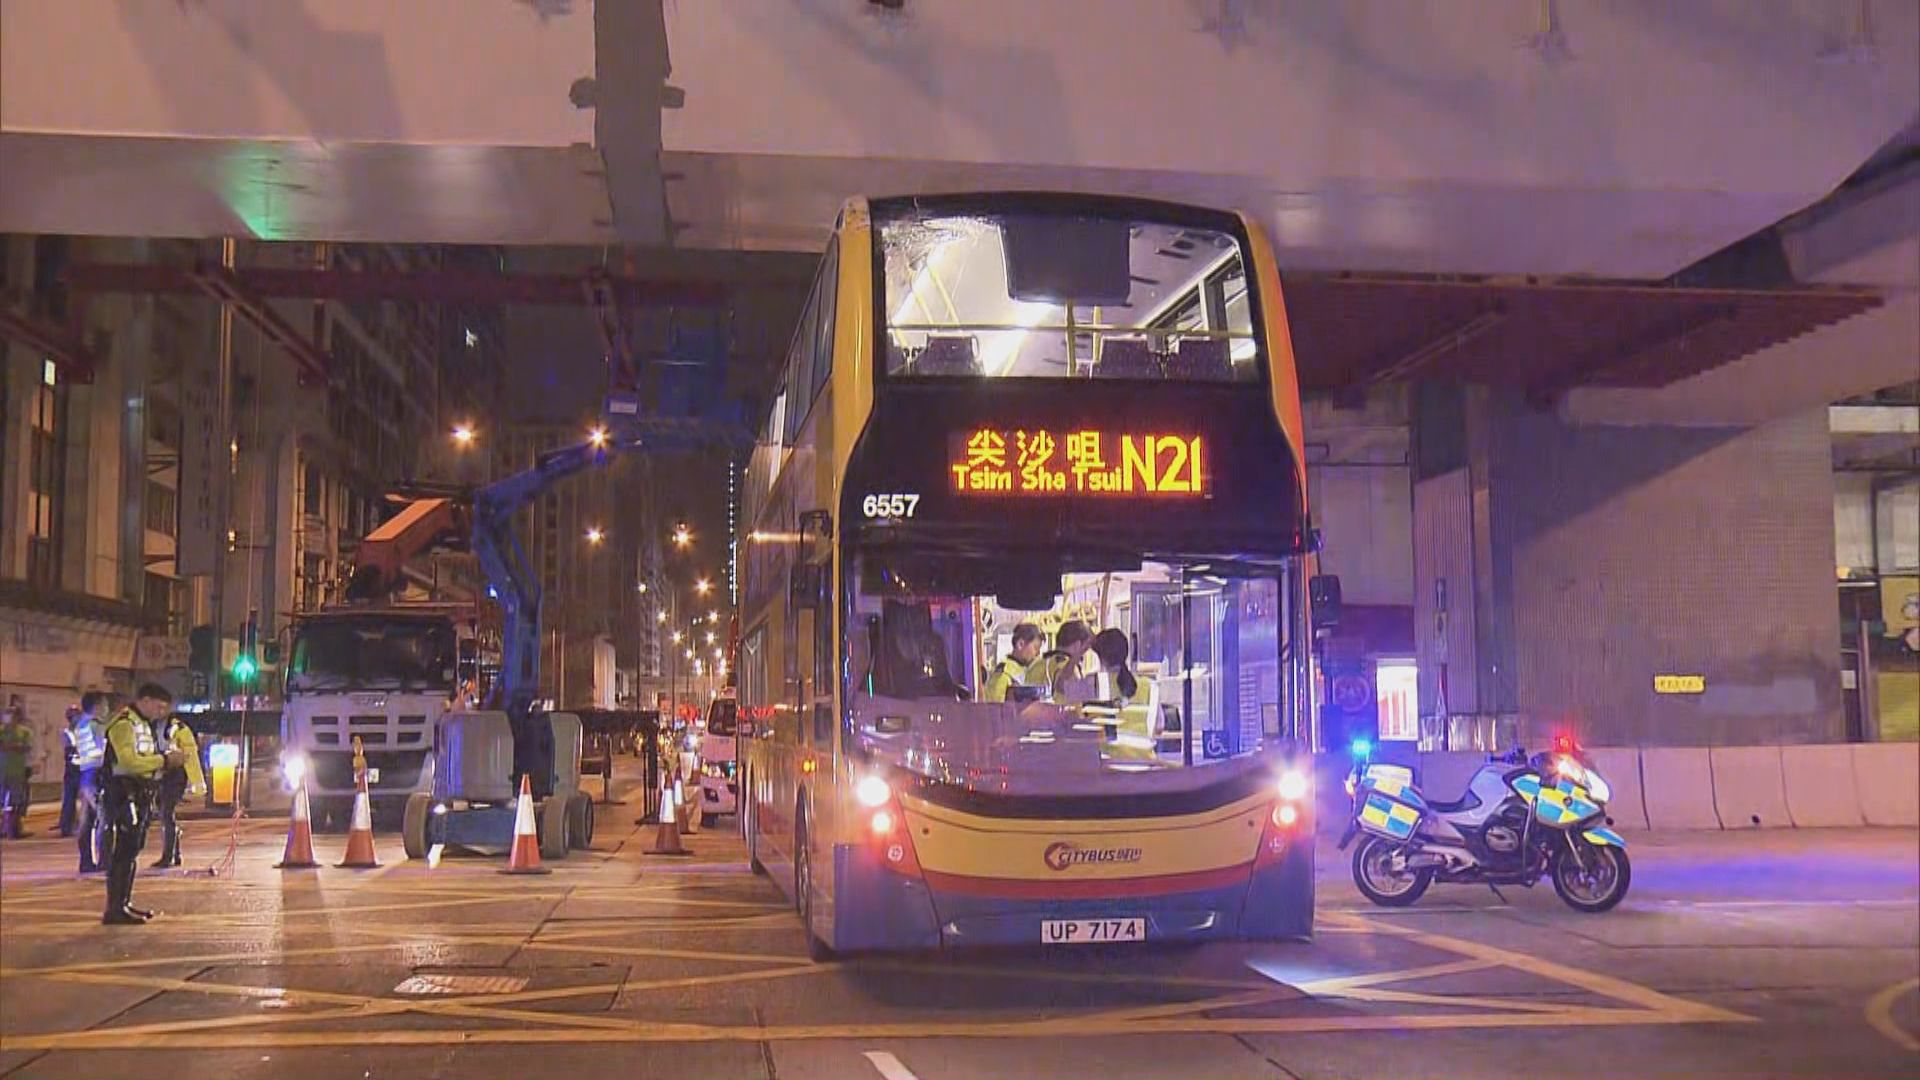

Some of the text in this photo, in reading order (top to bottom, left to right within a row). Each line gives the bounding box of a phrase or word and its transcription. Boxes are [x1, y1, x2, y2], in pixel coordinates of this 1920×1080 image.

[967, 429, 1106, 469] 尖沙咀
[1121, 434, 1202, 492] N21
[952, 462, 1121, 492] Tsim Sha Tsui
[863, 493, 920, 518] 6557
[1050, 921, 1136, 940] UP 7174
